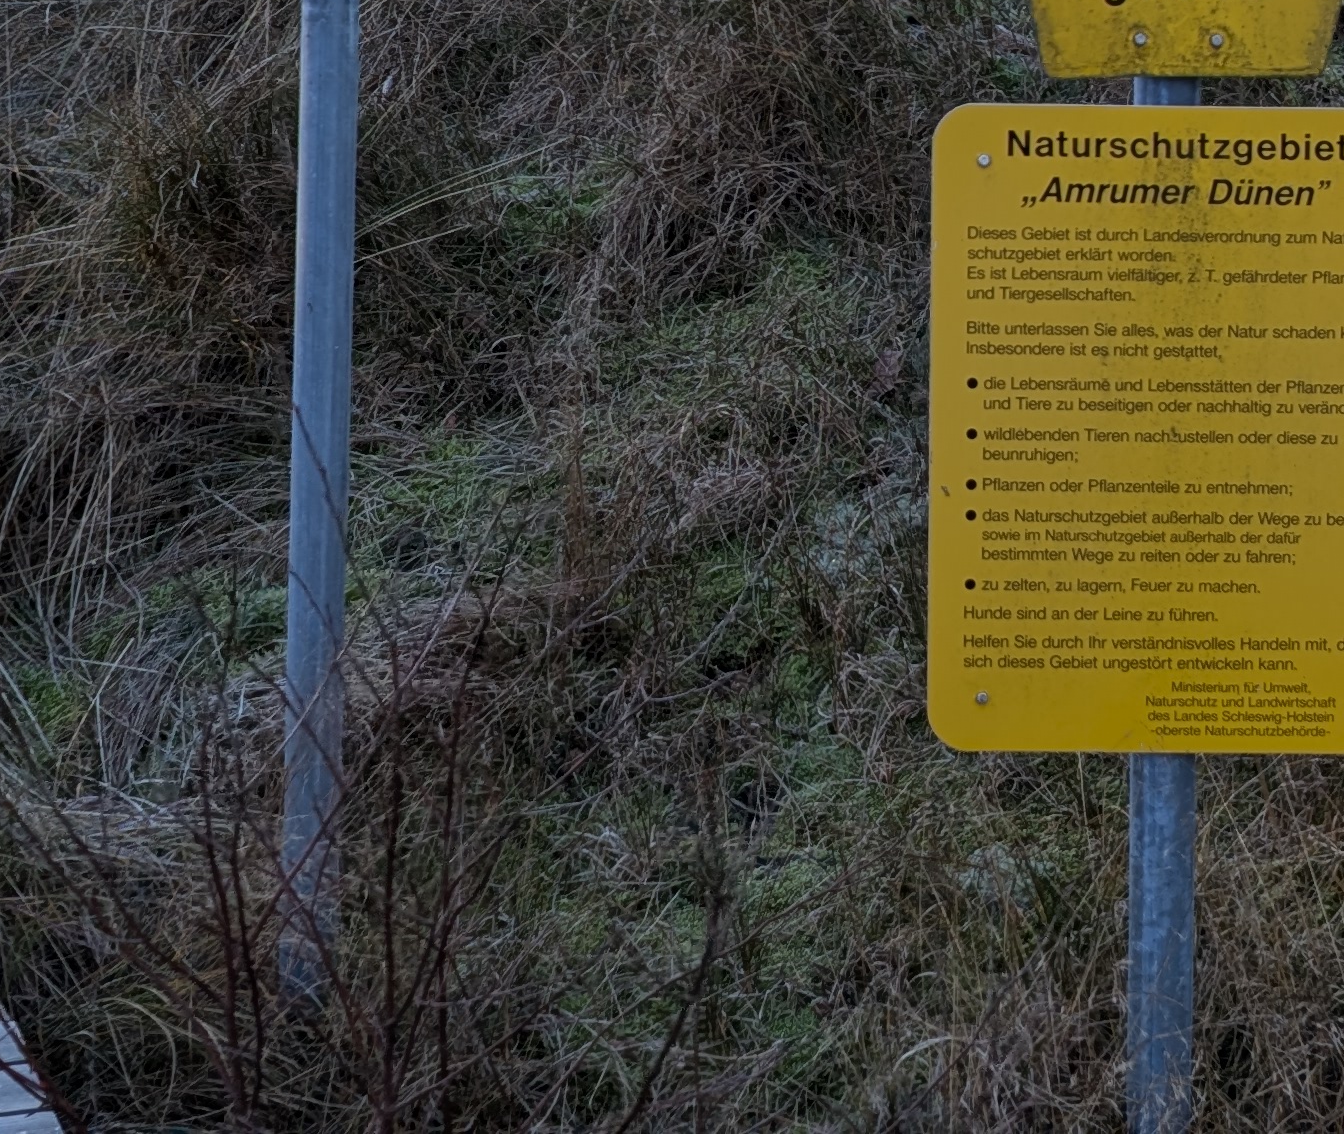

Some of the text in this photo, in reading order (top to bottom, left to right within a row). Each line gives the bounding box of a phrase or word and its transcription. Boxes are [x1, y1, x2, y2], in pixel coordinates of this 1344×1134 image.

[967, 226, 1016, 241] Dieses
[1022, 227, 1070, 241] Gebiet
[1075, 228, 1091, 241] ist
[1096, 228, 1138, 242] durch
[1143, 229, 1280, 245] Landesverordnung
[1285, 233, 1316, 244] zum
[967, 247, 1176, 263] schutzgebiet erklärt worden.
[967, 267, 986, 281] Es
[991, 267, 1006, 281] ist
[1011, 268, 1102, 282] Lebensraum
[1107, 268, 1183, 284] vielfältiger,
[1188, 271, 1200, 282] z.
[1206, 270, 1217, 283] T.
[1223, 270, 1306, 286] gefährdeter
[967, 287, 1135, 304] und Tiergesellschaften.
[967, 321, 1000, 335] Bitte
[1005, 322, 1088, 336] unterlassen
[1093, 323, 1116, 337] Sie
[1122, 323, 1158, 339] alles,
[1163, 327, 1193, 338] was
[1198, 324, 1222, 338] der
[1228, 325, 1268, 338] Natur
[1272, 325, 1335, 339] schaden
[967, 342, 1065, 356] Insbesondere
[1070, 343, 1086, 356] ist
[1091, 347, 1108, 357] es
[1113, 343, 1148, 357] nicht
[983, 376, 1005, 391] die
[1010, 377, 1110, 392] Lebensräume
[1115, 378, 1143, 392] und
[1148, 379, 1251, 393] Lebensstätten
[1256, 380, 1280, 394] der
[983, 397, 1011, 410] und
[1016, 397, 1051, 411] Tiere
[1056, 401, 1073, 411] zu
[1078, 398, 1153, 415] beseitigen
[1158, 399, 1191, 413] oder
[1196, 399, 1271, 416] nachhaltig
[1276, 403, 1293, 414] zu
[983, 428, 1079, 443] wildlebenden
[1084, 429, 1129, 443] Tieren
[1238, 431, 1272, 445] oder
[1277, 431, 1316, 445] diese
[1321, 435, 1338, 445] zu
[983, 448, 1078, 464] beunruhigen;
[982, 478, 1293, 497] Pflanzen oder Pflanzenteile zu entnehmen;
[982, 509, 1009, 523] das
[1014, 509, 1147, 526] Naturschutzgebiet
[1152, 511, 1224, 525] außerhalb
[1229, 512, 1253, 526] der
[1258, 512, 1299, 529] Wege
[1304, 516, 1321, 526] zu
[982, 528, 1300, 546] sowie im Naturschutzgebiet außerhalb der dafür
[982, 547, 1296, 566] bestimmten Wege zu reiten oder zu fahren;
[982, 578, 1260, 595] zu zelten, zu lagern, Feuer zu machen.
[964, 606, 1218, 622] Hunde sind an der Leine zu führen.
[964, 635, 1009, 650] Helfen
[1014, 635, 1037, 650] Sie
[1041, 635, 1084, 650] durch
[1089, 636, 1107, 650] Ihr
[1112, 636, 1235, 651] verständnisvolles
[1240, 637, 1300, 652] Handeln
[1305, 638, 1331, 654] mit,
[964, 655, 1297, 673] sich dieses Gebiet ungestört entwickeln kann.
[1171, 682, 1311, 695] Ministerium für Umwelt,
[1146, 696, 1336, 708] Naturschutz und Landwirtschaft
[1148, 710, 1334, 726] des Landes Schleswig-Holstein
[1204, 726, 1330, 737] Naturschutzbehörde-
